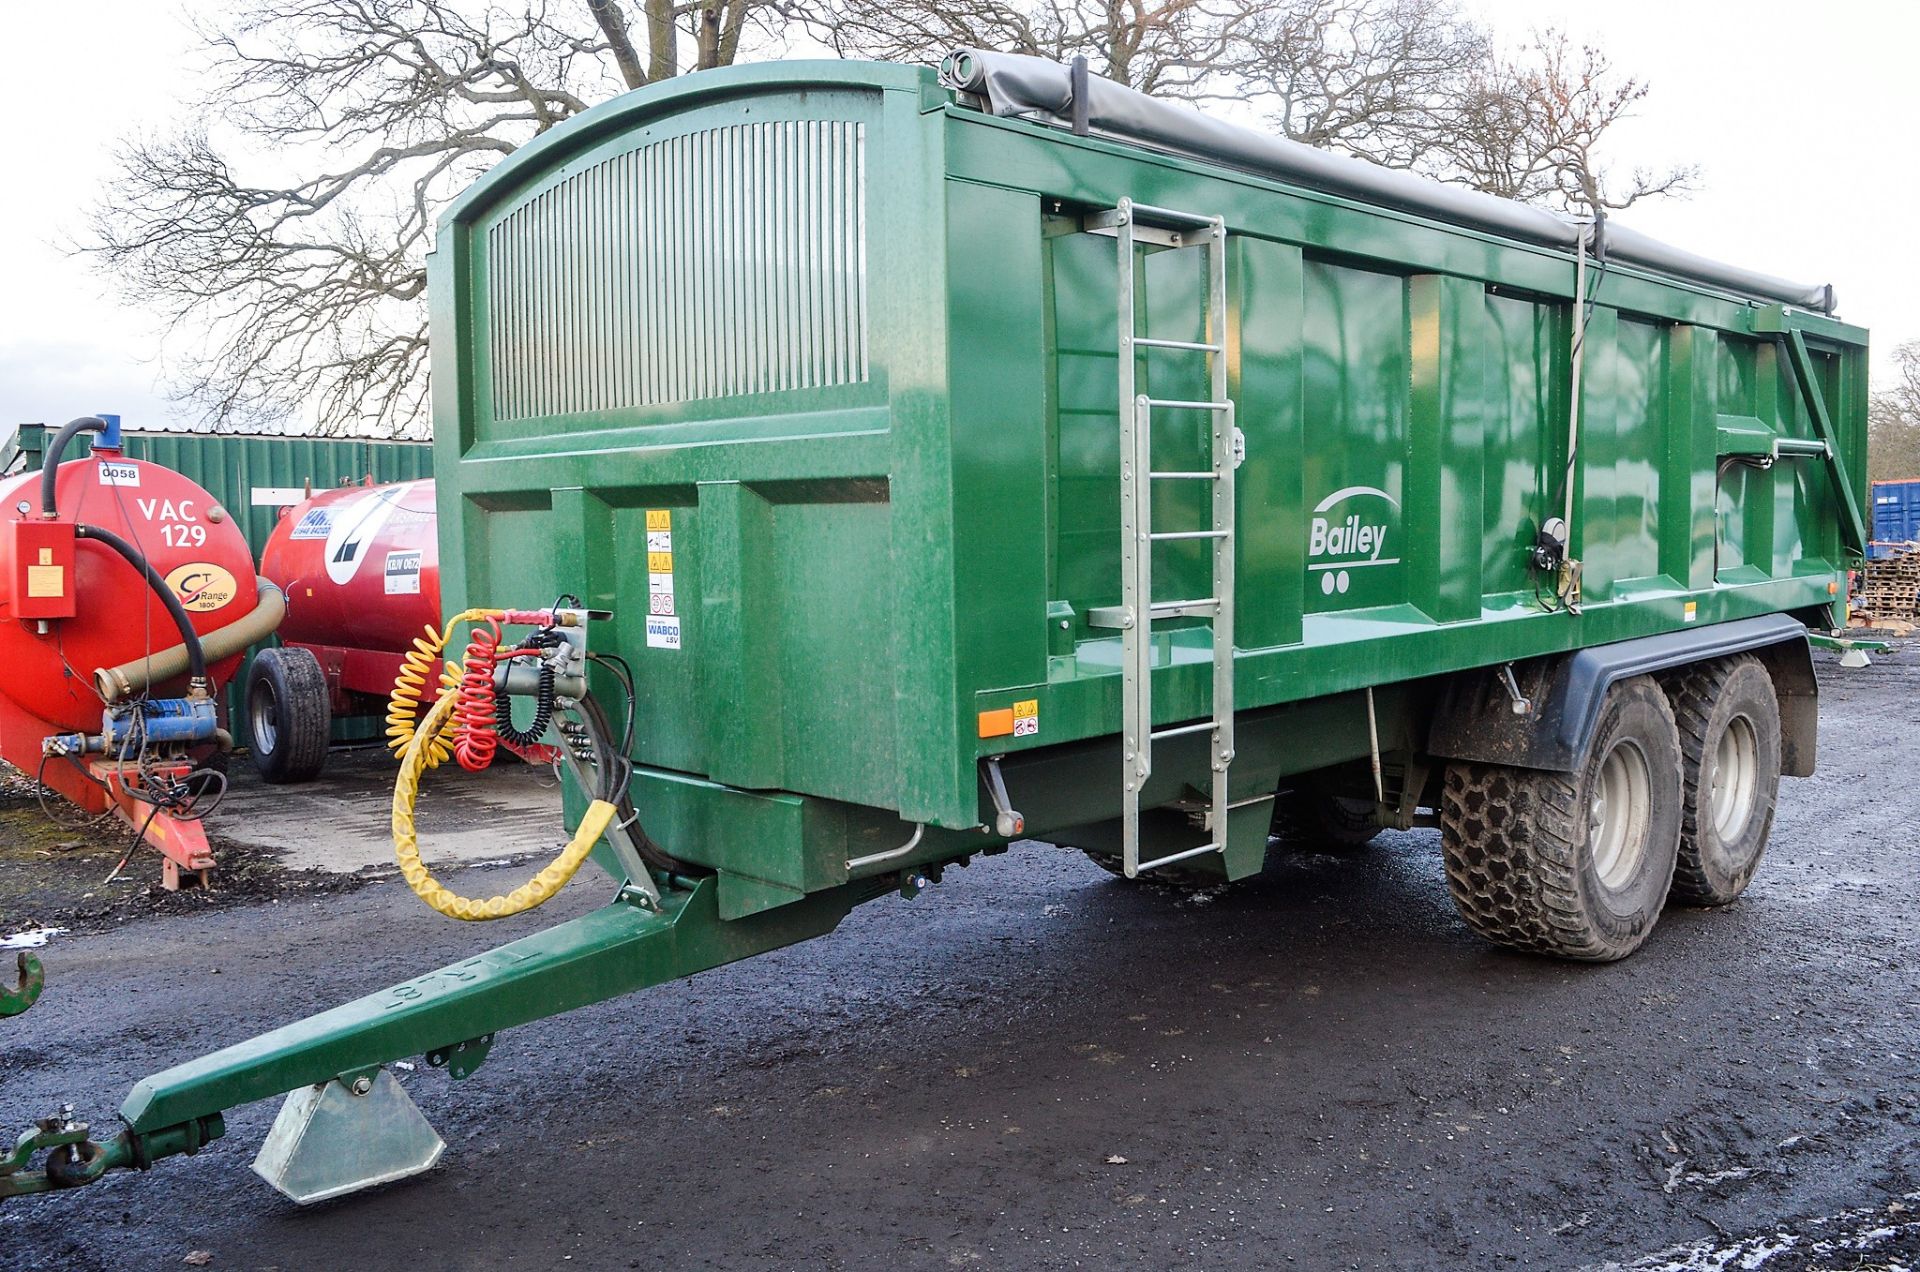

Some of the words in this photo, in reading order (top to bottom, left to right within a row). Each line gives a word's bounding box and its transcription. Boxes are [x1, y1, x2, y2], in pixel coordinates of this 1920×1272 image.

[102, 468, 136, 479] 0058
[136, 498, 197, 522] VAC
[160, 524, 207, 547] 129
[1308, 514, 1387, 561] Bailey
[201, 591, 228, 602] Range
[648, 624, 679, 636] WABCO
